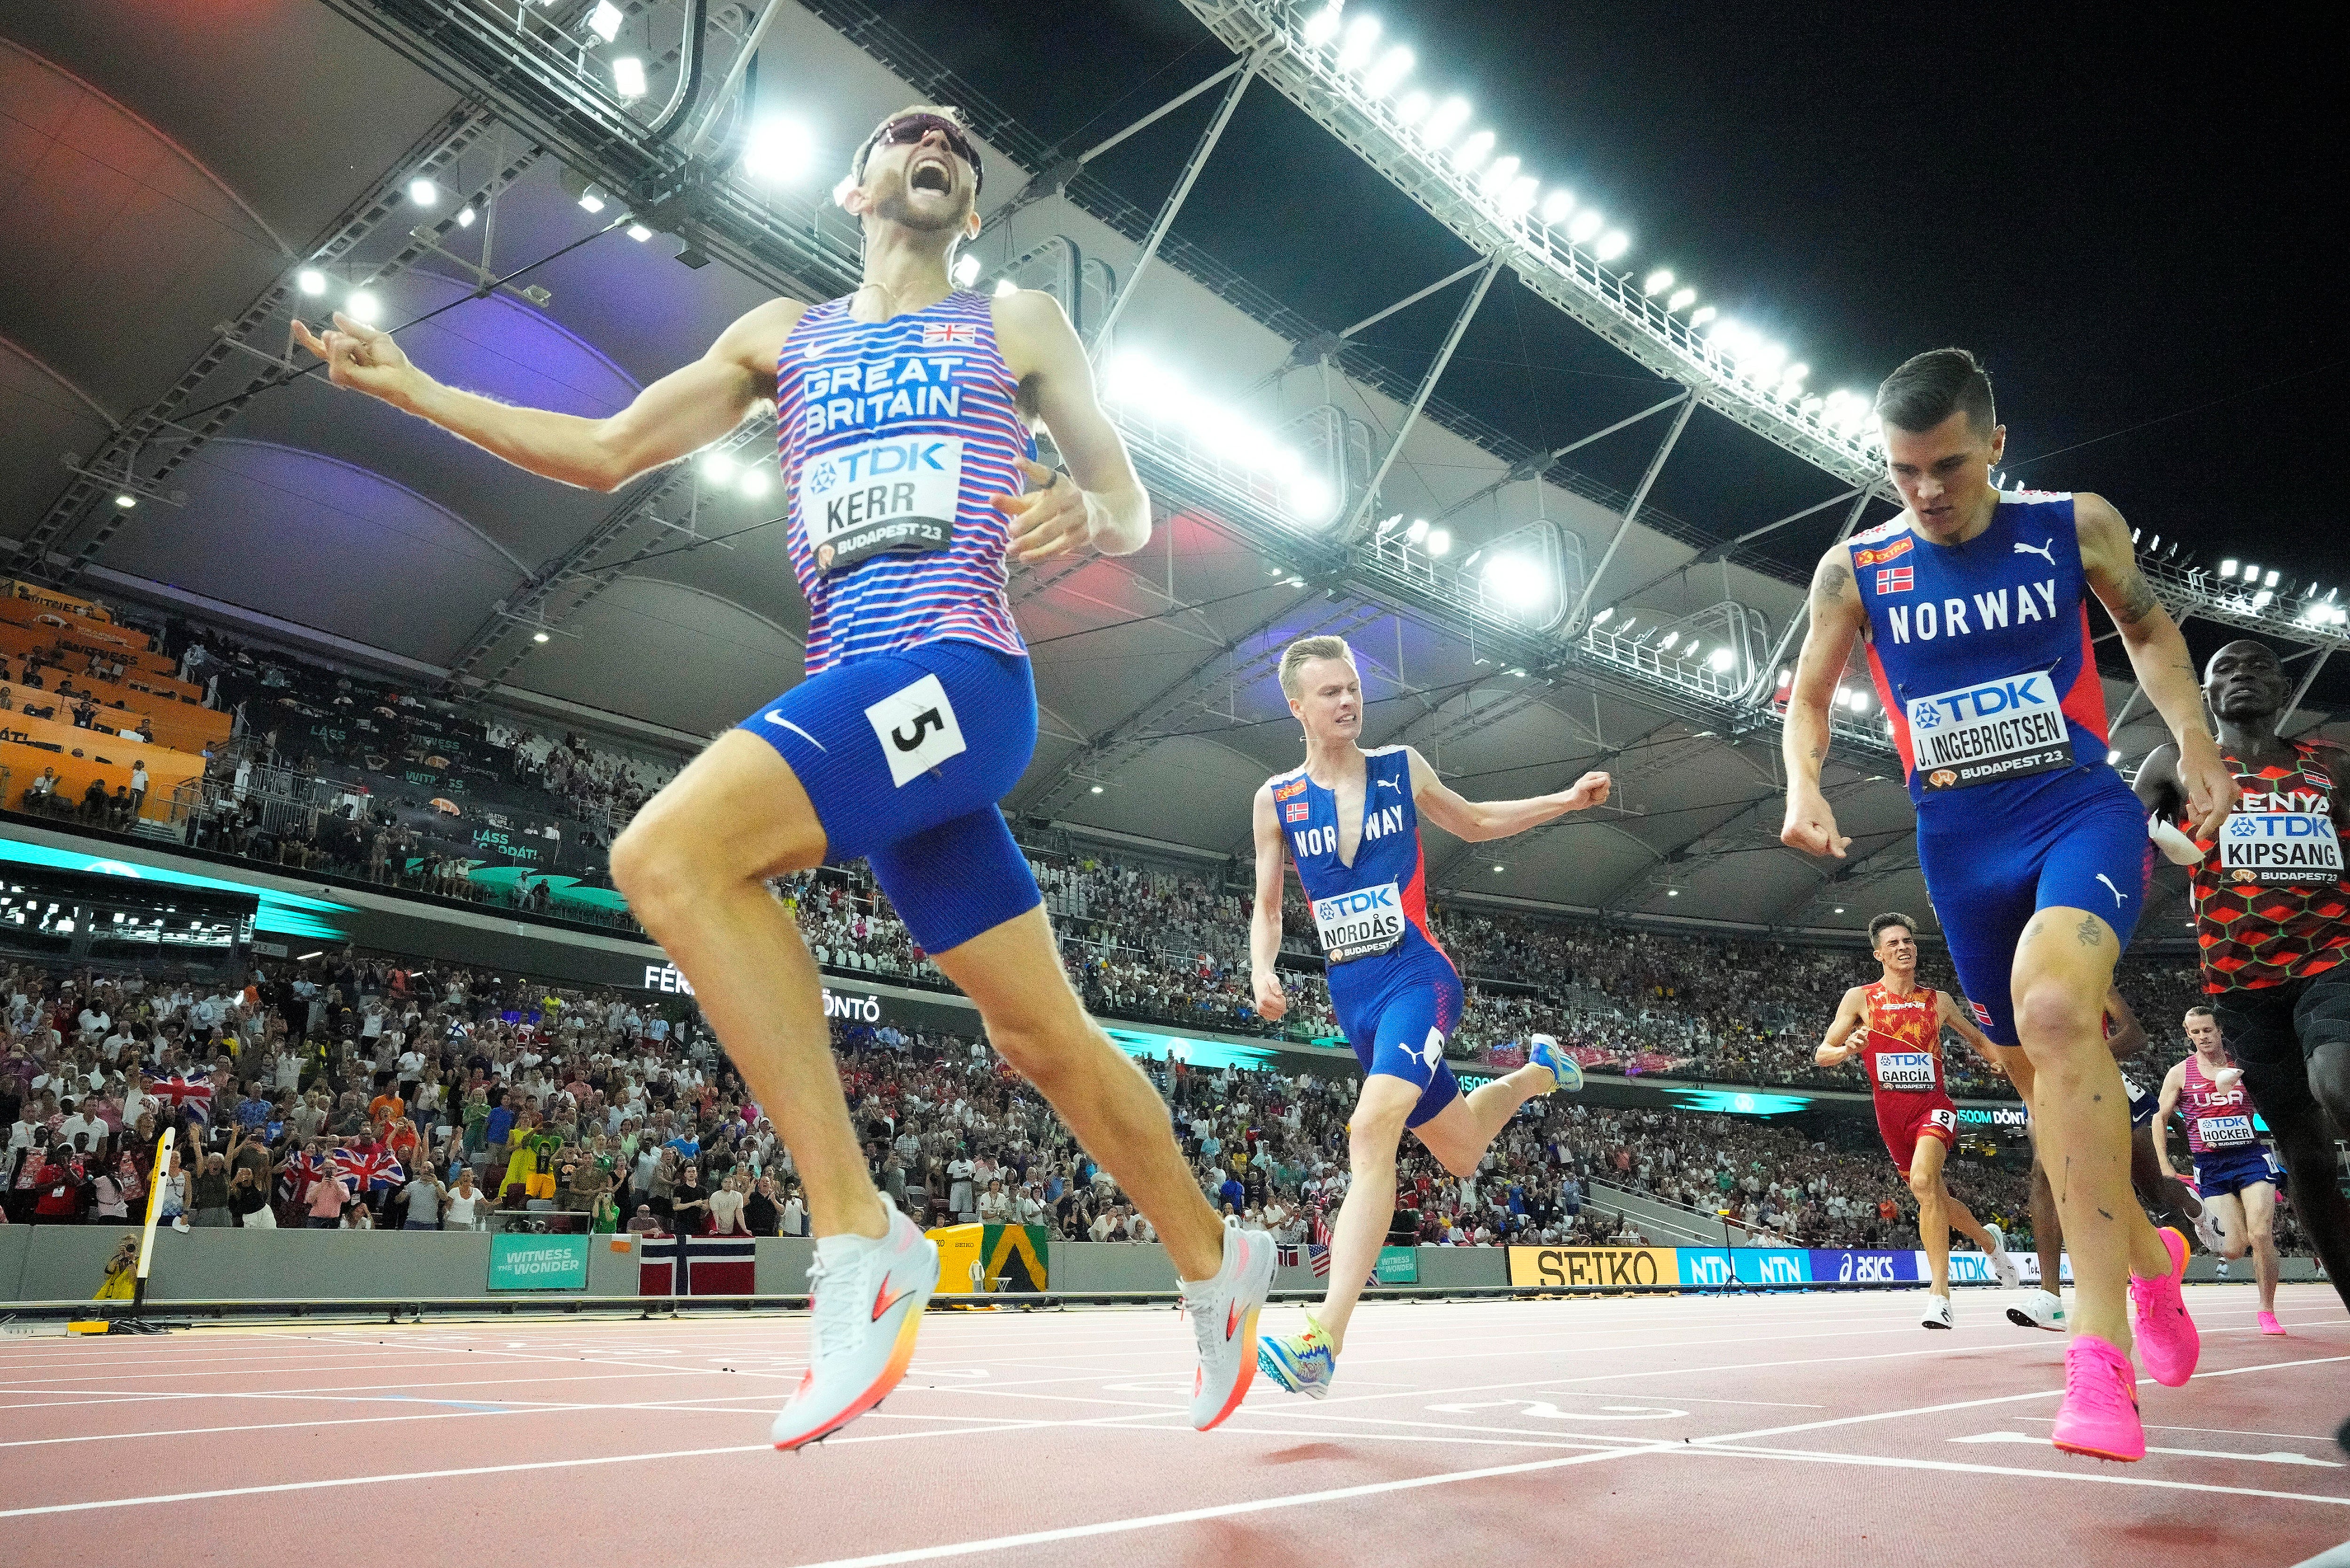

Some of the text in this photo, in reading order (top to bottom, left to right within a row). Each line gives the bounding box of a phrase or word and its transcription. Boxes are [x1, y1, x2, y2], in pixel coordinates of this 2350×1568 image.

[803, 357, 963, 403] GREAT
[805, 386, 960, 438] BRITAIN
[838, 443, 947, 483] TDK
[826, 482, 916, 534] KERR
[837, 523, 920, 555] BUDAPEST
[1875, 542, 1909, 560] EXTRA
[1888, 579, 2057, 644] NORWAY
[1936, 677, 2045, 722] TDK
[892, 707, 944, 752] 5
[1918, 711, 2061, 767] J. INGEBRIGTSEN
[1960, 750, 2064, 780] BUDAPEST 23
[406, 771, 464, 789] WITNSS
[2232, 791, 2330, 815] ENYA
[473, 829, 509, 844] LÁSS
[2256, 816, 2331, 838] TDK
[478, 843, 538, 860] CODÁT!
[2228, 843, 2337, 866] KIPSANG
[2261, 872, 2326, 881] BUDAPEST
[1332, 888, 1394, 917] TDK
[1324, 914, 1399, 946] NORDÅS
[1344, 941, 1391, 957] BUDAPEST
[645, 963, 880, 1022] FÉR ÖNTŐ
[1890, 1055, 1930, 1066] TDK
[1458, 1075, 1495, 1092] 1500
[1882, 1068, 1931, 1082] GARCÍA
[2193, 1090, 2243, 1107] USA
[1939, 1111, 1950, 1125] 8
[1993, 1108, 2026, 1125] DÖNT
[2211, 1117, 2246, 1128] TDK
[2203, 1128, 2251, 1141] HOCKER
[506, 1248, 572, 1264] WITNESS
[512, 1259, 579, 1275] WONDER
[1381, 1256, 1410, 1265] WITNESS
[1385, 1263, 1414, 1273] WONDER
[1538, 1250, 1658, 1286] SEIKO
[1690, 1256, 1736, 1284] NTN
[1759, 1256, 1801, 1283] NTN
[1950, 1256, 1990, 1279] TDK
[1424, 1399, 1691, 1420] 2
